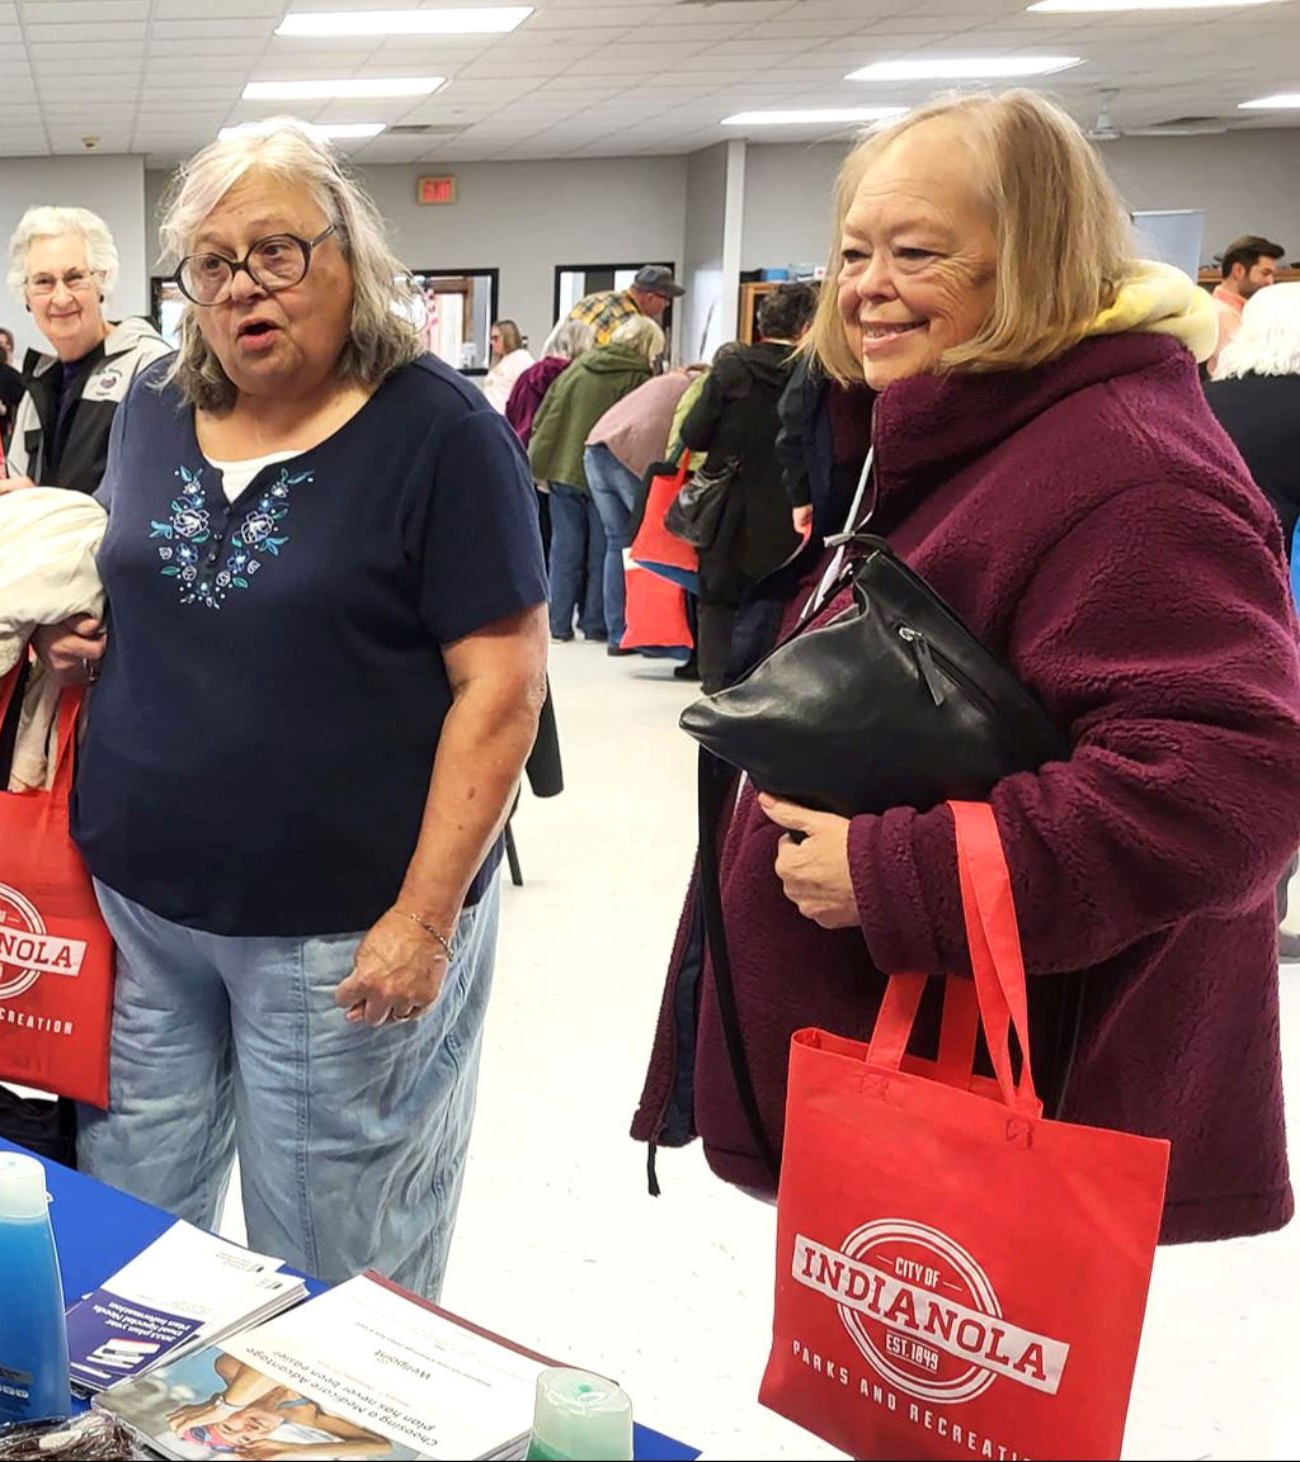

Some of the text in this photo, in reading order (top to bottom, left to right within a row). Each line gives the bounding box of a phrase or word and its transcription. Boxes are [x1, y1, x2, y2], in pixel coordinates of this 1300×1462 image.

[895, 1256, 940, 1288] CITY OF
[801, 1247, 1048, 1382] INDIANOLA
[246, 1347, 308, 1386] Advantage
[273, 1350, 309, 1372] easier
[374, 1349, 432, 1381] Wellpoint
[885, 1333, 939, 1371] EST. 1849
[310, 1370, 341, 1389] been
[310, 1379, 368, 1415] Medicare
[343, 1386, 377, 1406] never
[378, 1400, 403, 1422] has
[792, 1339, 1031, 1461] PARKS AND RECREATI
[379, 1414, 438, 1448] Choosing
[403, 1414, 436, 1432] plan
